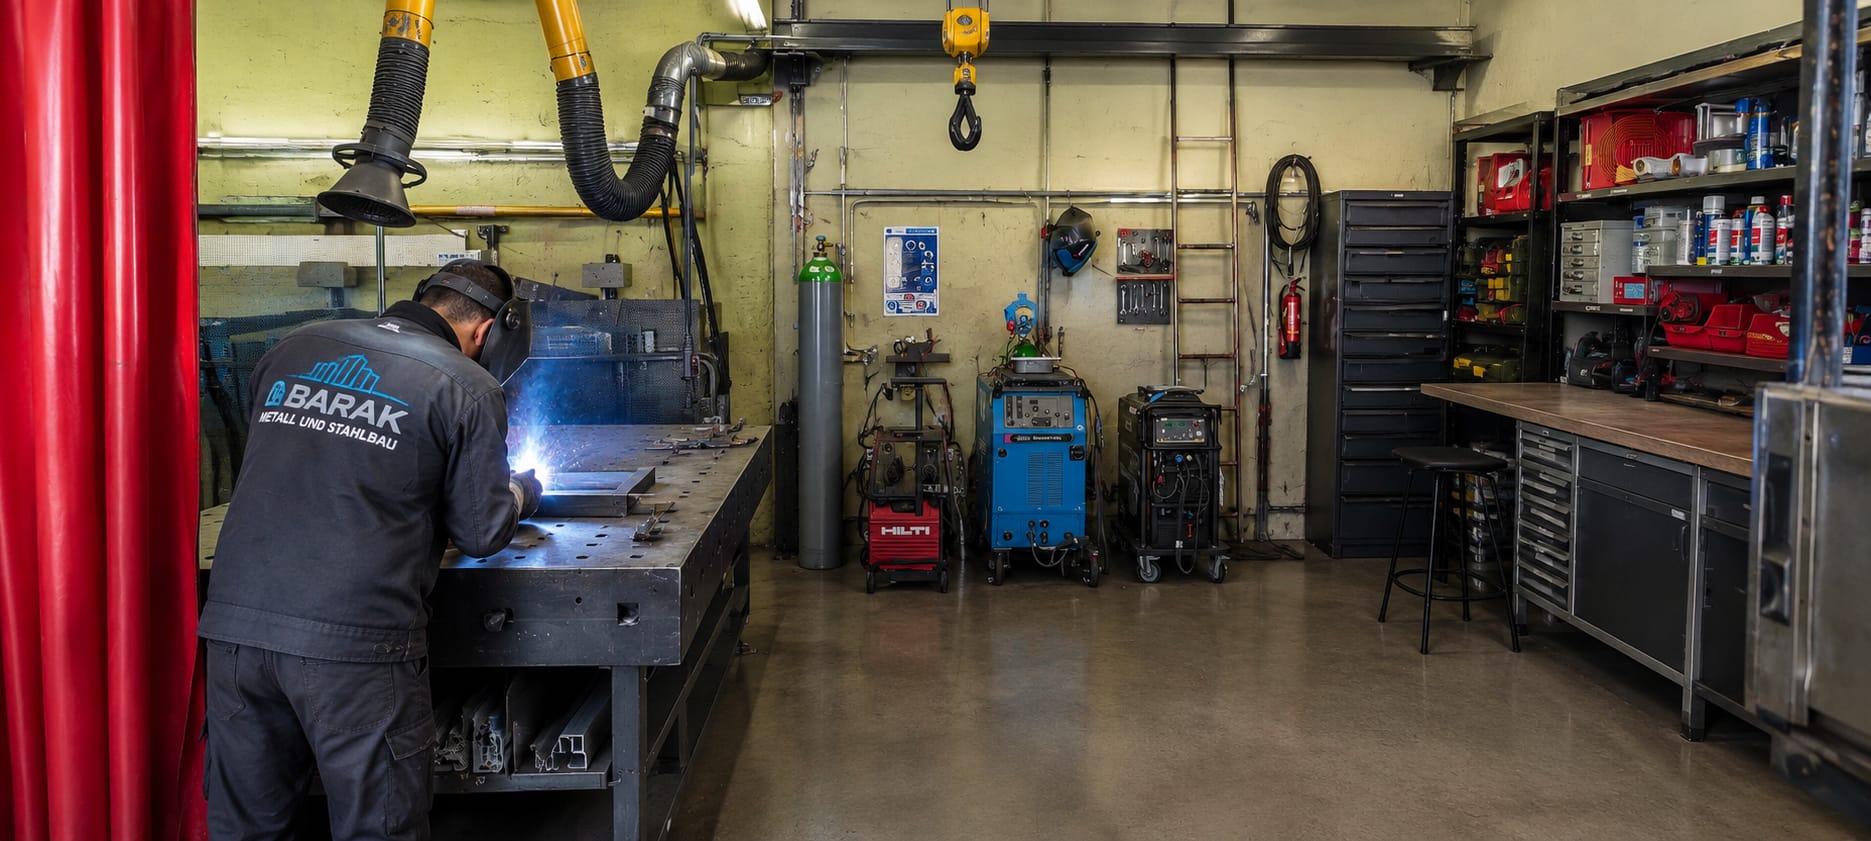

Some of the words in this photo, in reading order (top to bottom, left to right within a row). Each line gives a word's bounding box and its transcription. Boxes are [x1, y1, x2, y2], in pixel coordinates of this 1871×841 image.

[284, 384, 408, 434] BARAK
[259, 411, 296, 425] METALL
[299, 416, 326, 431] UND
[327, 422, 397, 450] STAHLBAU
[881, 526, 930, 535] HILTI
